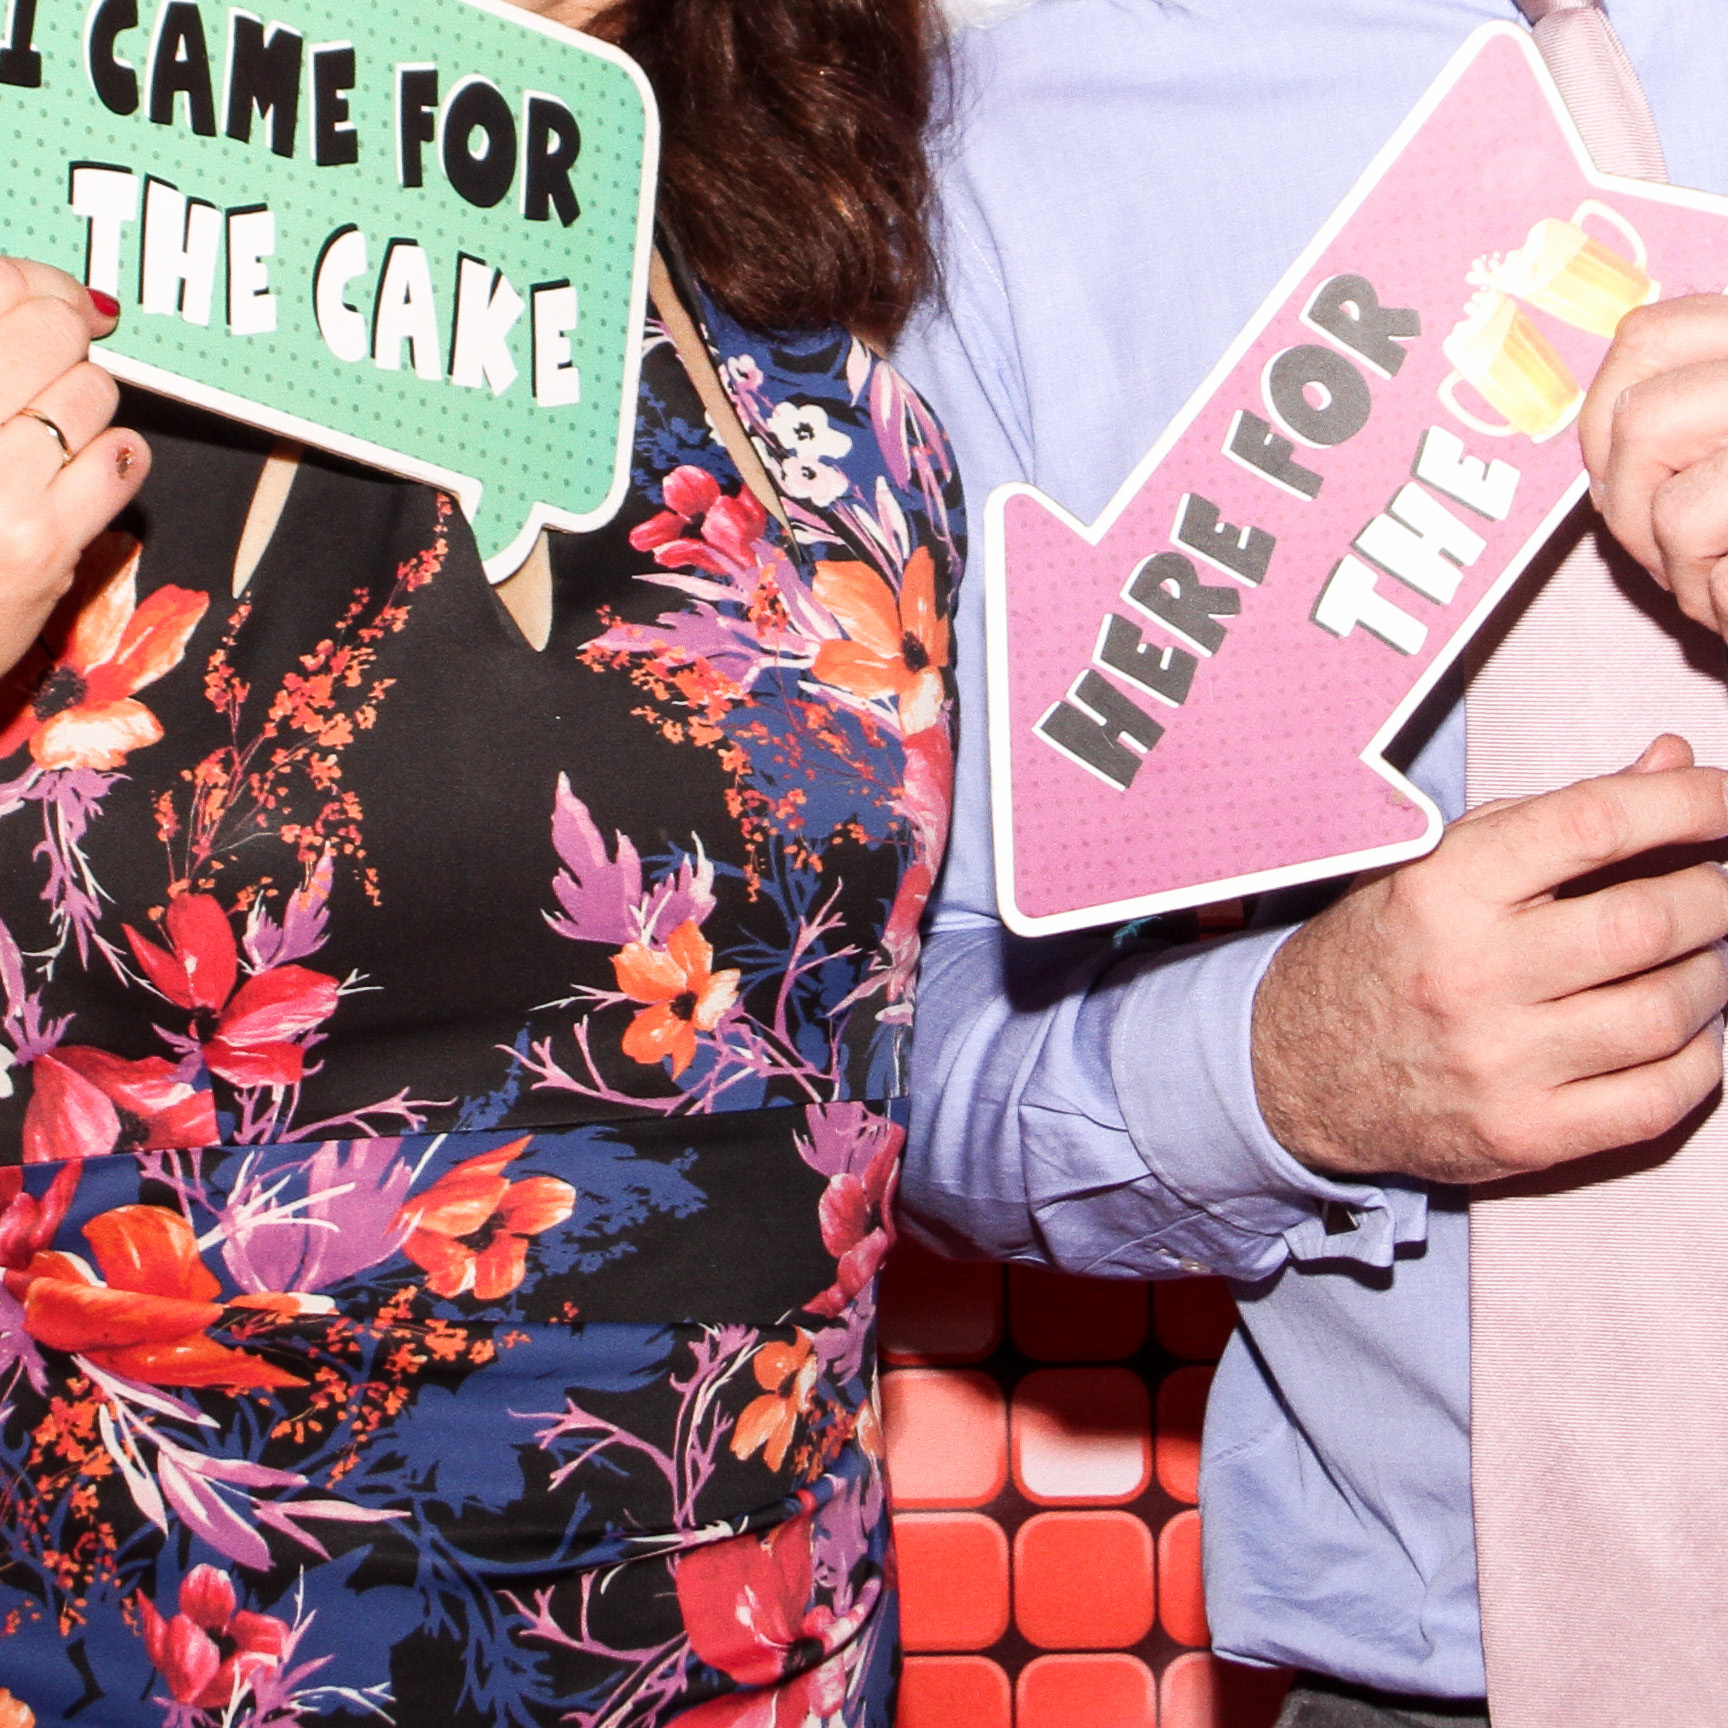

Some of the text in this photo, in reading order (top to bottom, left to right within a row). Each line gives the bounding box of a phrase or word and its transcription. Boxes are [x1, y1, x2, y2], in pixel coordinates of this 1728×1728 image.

[396, 62, 581, 228] FOR
[69, 161, 581, 408] THE CAKE
[1031, 274, 1420, 791] HERE FOR
[1310, 425, 1520, 655] THE
